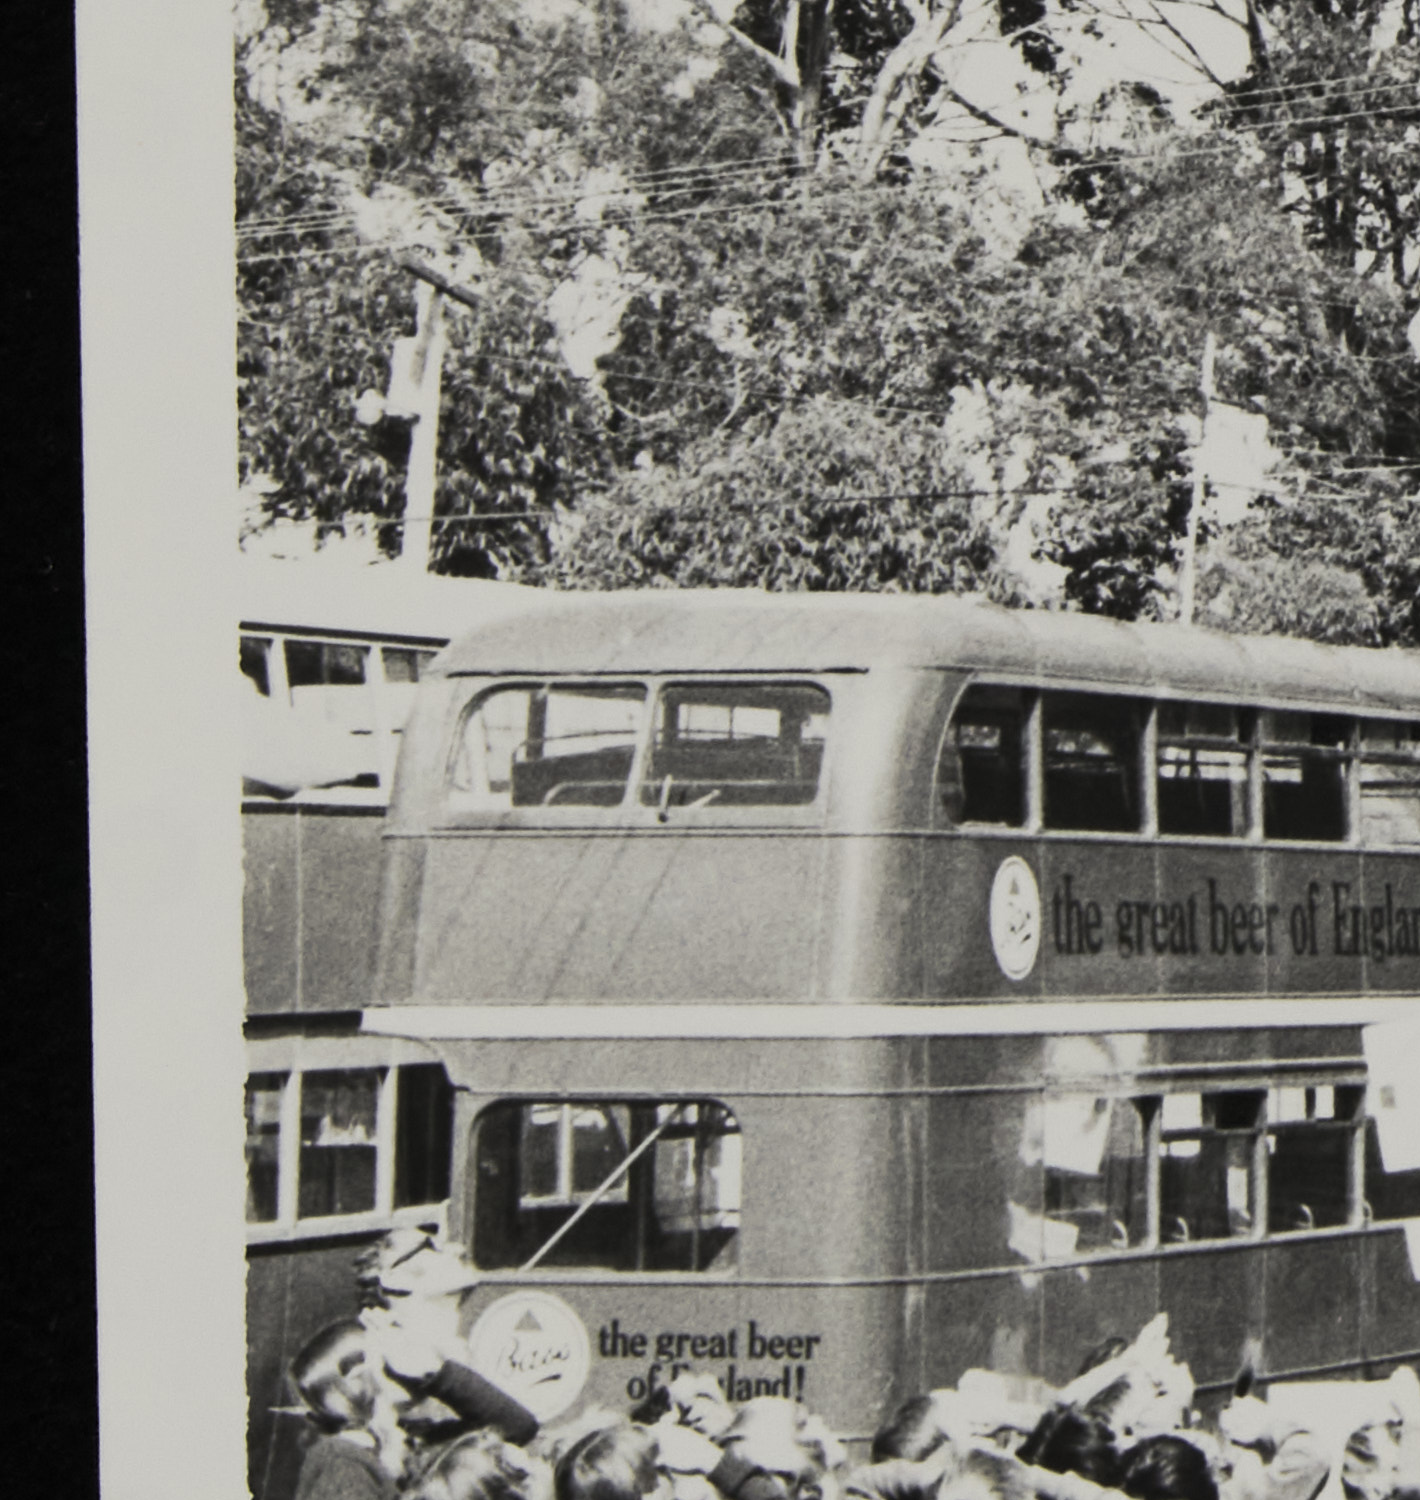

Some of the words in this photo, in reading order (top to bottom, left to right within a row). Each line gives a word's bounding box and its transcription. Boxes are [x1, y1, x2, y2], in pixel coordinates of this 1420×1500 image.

[1052, 873, 1103, 955] the
[1116, 894, 1201, 960] great
[1207, 877, 1279, 956] beer
[1290, 880, 1320, 956] of
[599, 1318, 647, 1358] the
[656, 1328, 737, 1362] great
[749, 1320, 821, 1360] beer
[627, 1363, 662, 1400] of
[671, 1363, 805, 1403] land!
